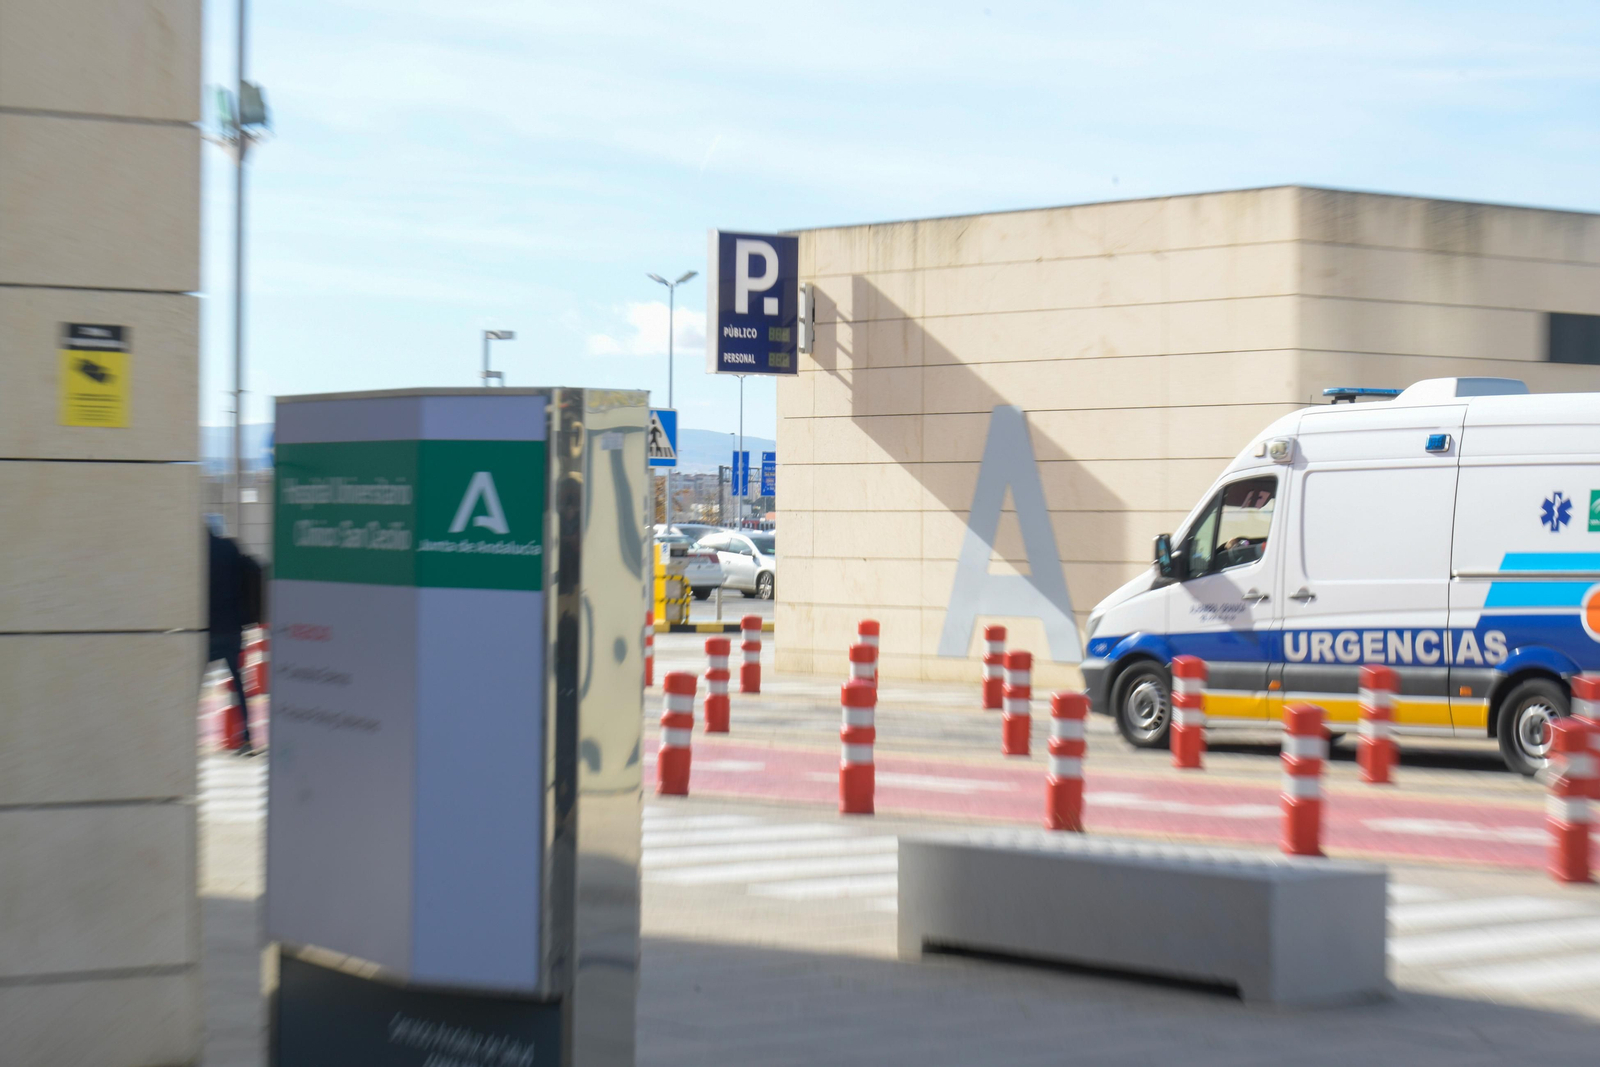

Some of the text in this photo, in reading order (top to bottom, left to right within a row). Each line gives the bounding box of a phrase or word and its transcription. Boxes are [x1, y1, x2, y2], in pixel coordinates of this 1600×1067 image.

[723, 353, 756, 365] PERSONAL
[459, 539, 476, 553] de
[1283, 629, 1508, 666] URGENCIAS
